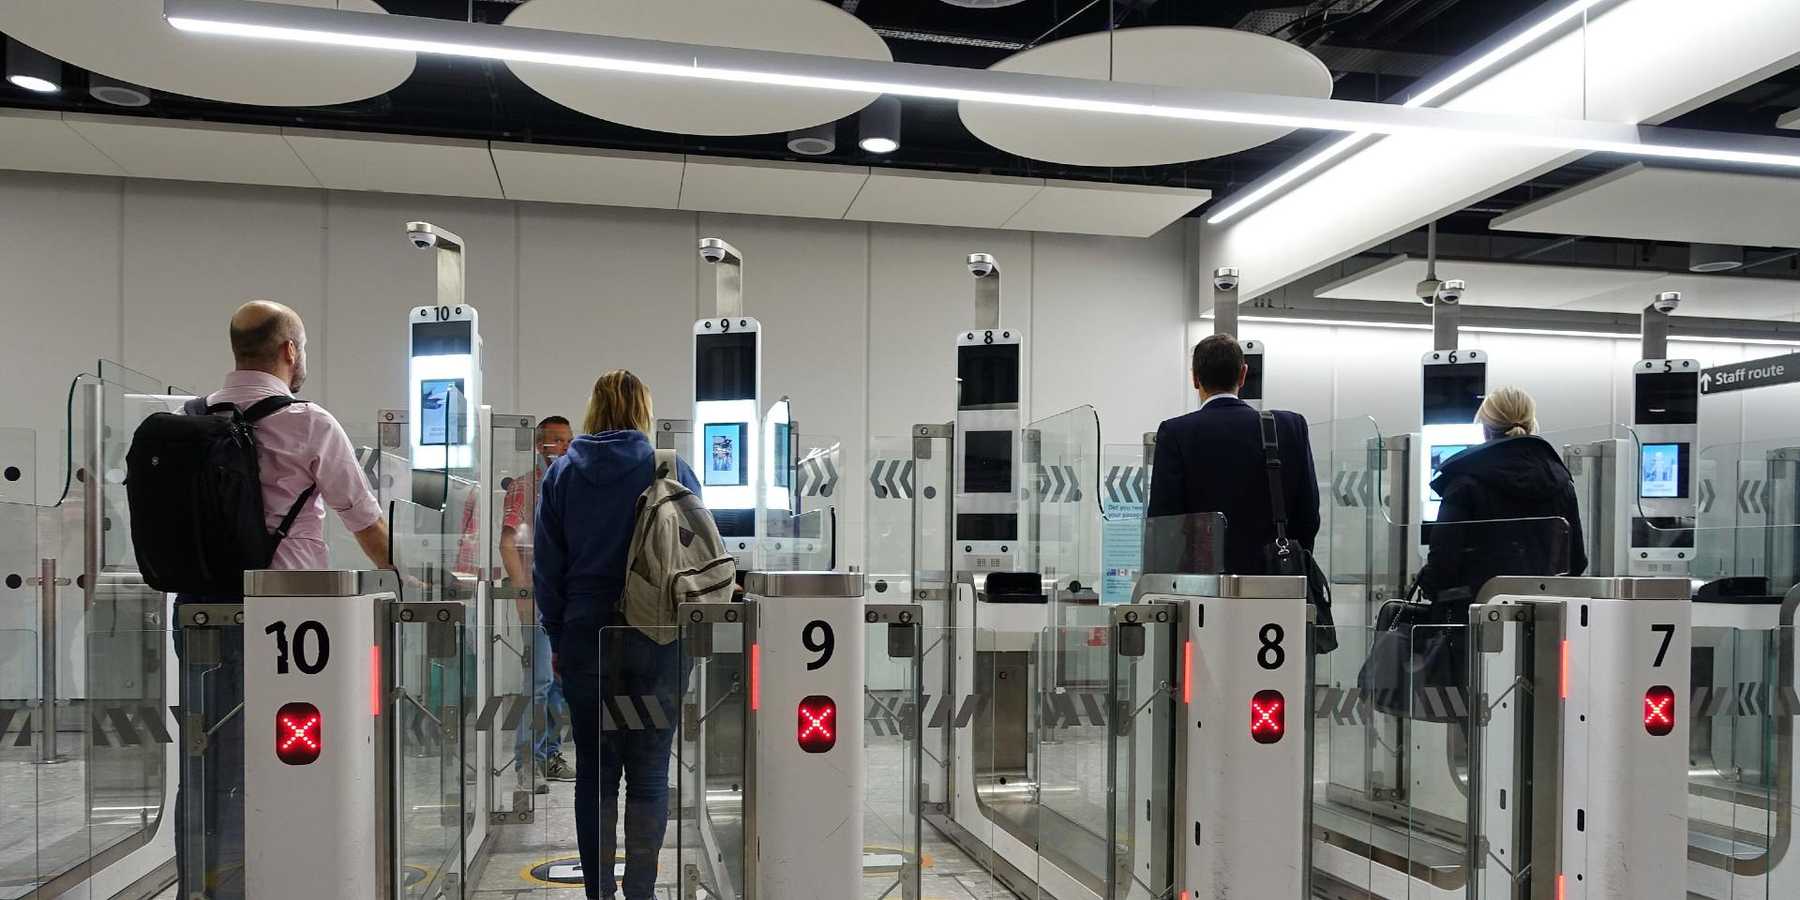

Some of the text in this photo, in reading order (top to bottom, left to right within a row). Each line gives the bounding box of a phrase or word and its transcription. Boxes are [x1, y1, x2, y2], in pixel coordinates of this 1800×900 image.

[434, 305, 450, 322] 10
[720, 318, 730, 334] 9
[984, 330, 994, 345] 8
[1448, 350, 1458, 364] 6
[1663, 360, 1673, 374] 5
[1715, 364, 1785, 385] Staff route
[265, 620, 330, 675] 10
[801, 619, 835, 671] 9
[1256, 622, 1286, 670] 8
[1651, 623, 1676, 668] 7
